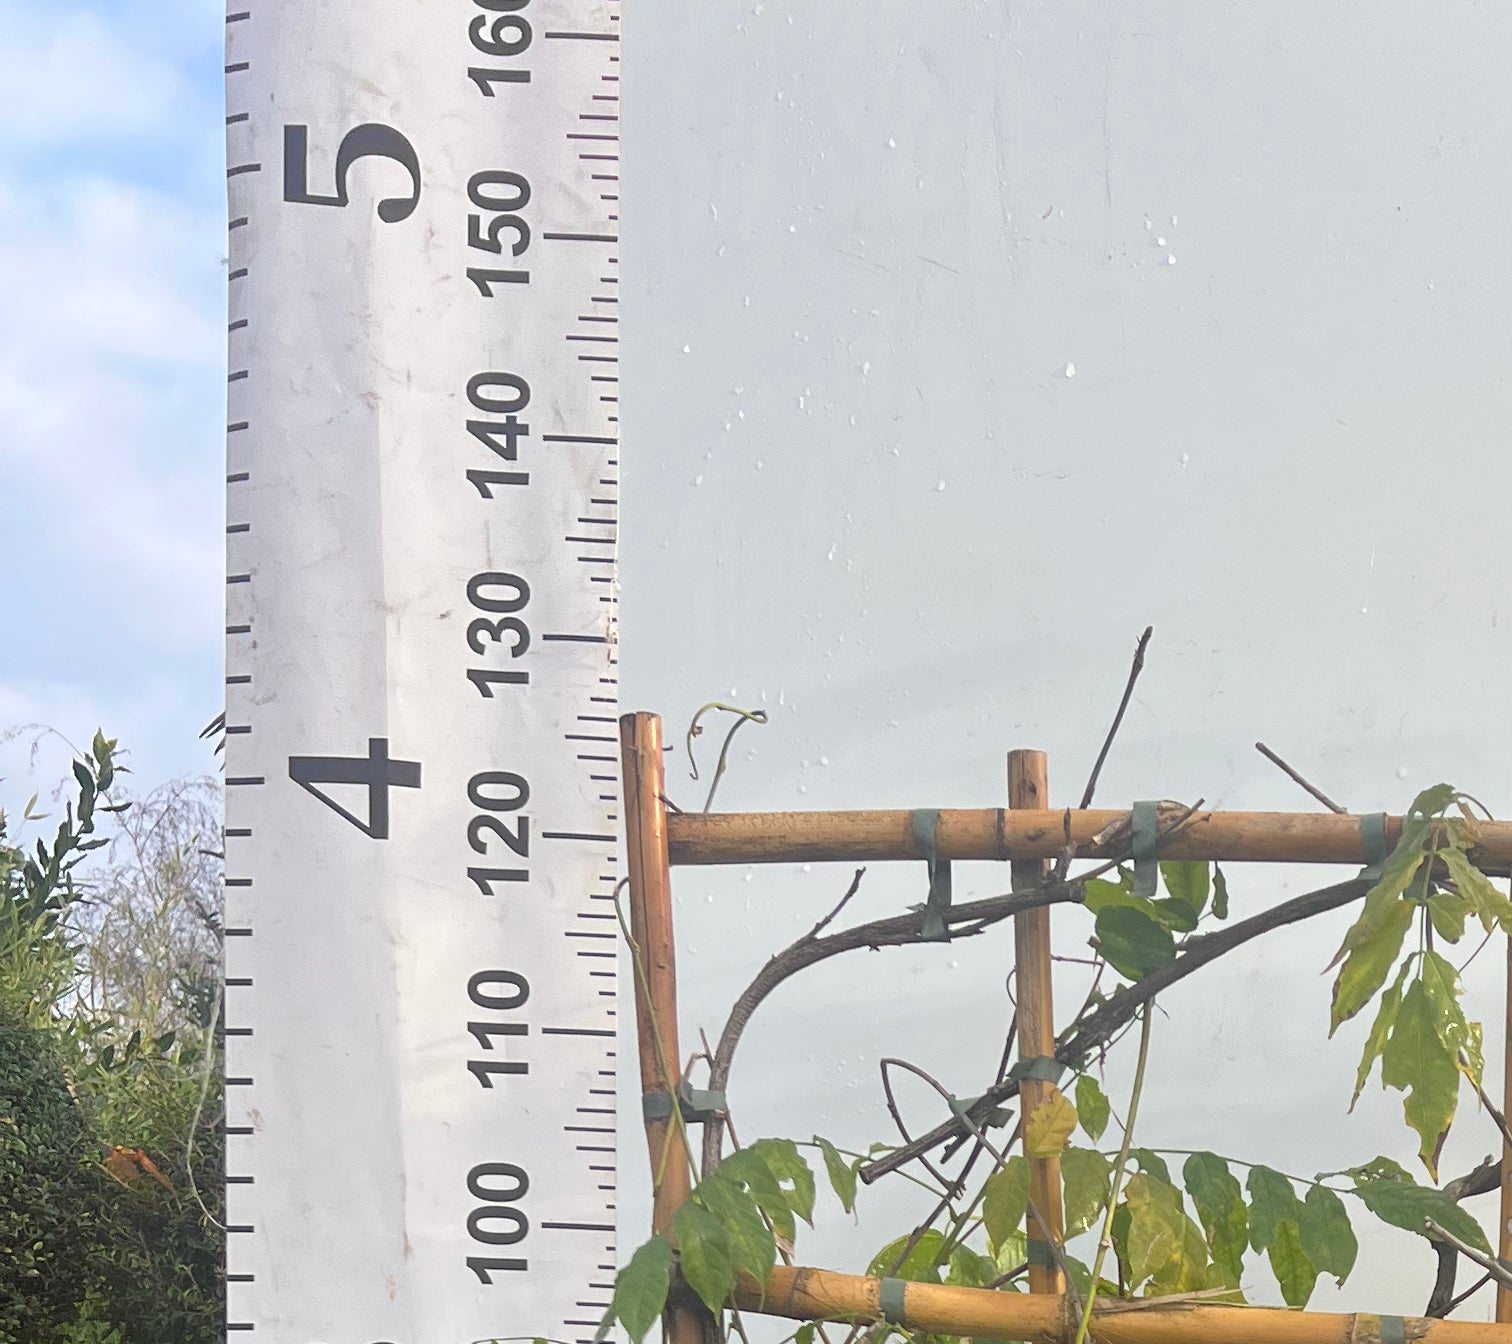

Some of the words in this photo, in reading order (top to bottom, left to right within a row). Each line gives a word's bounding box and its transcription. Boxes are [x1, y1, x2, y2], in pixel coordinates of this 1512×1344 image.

[283, 123, 421, 223] 5
[467, 170, 531, 298] 150
[466, 372, 531, 500] 140
[466, 572, 531, 699] 130
[288, 737, 421, 840] 4
[467, 771, 530, 896] 120
[467, 970, 530, 1089] 110
[466, 1162, 530, 1285] 100
